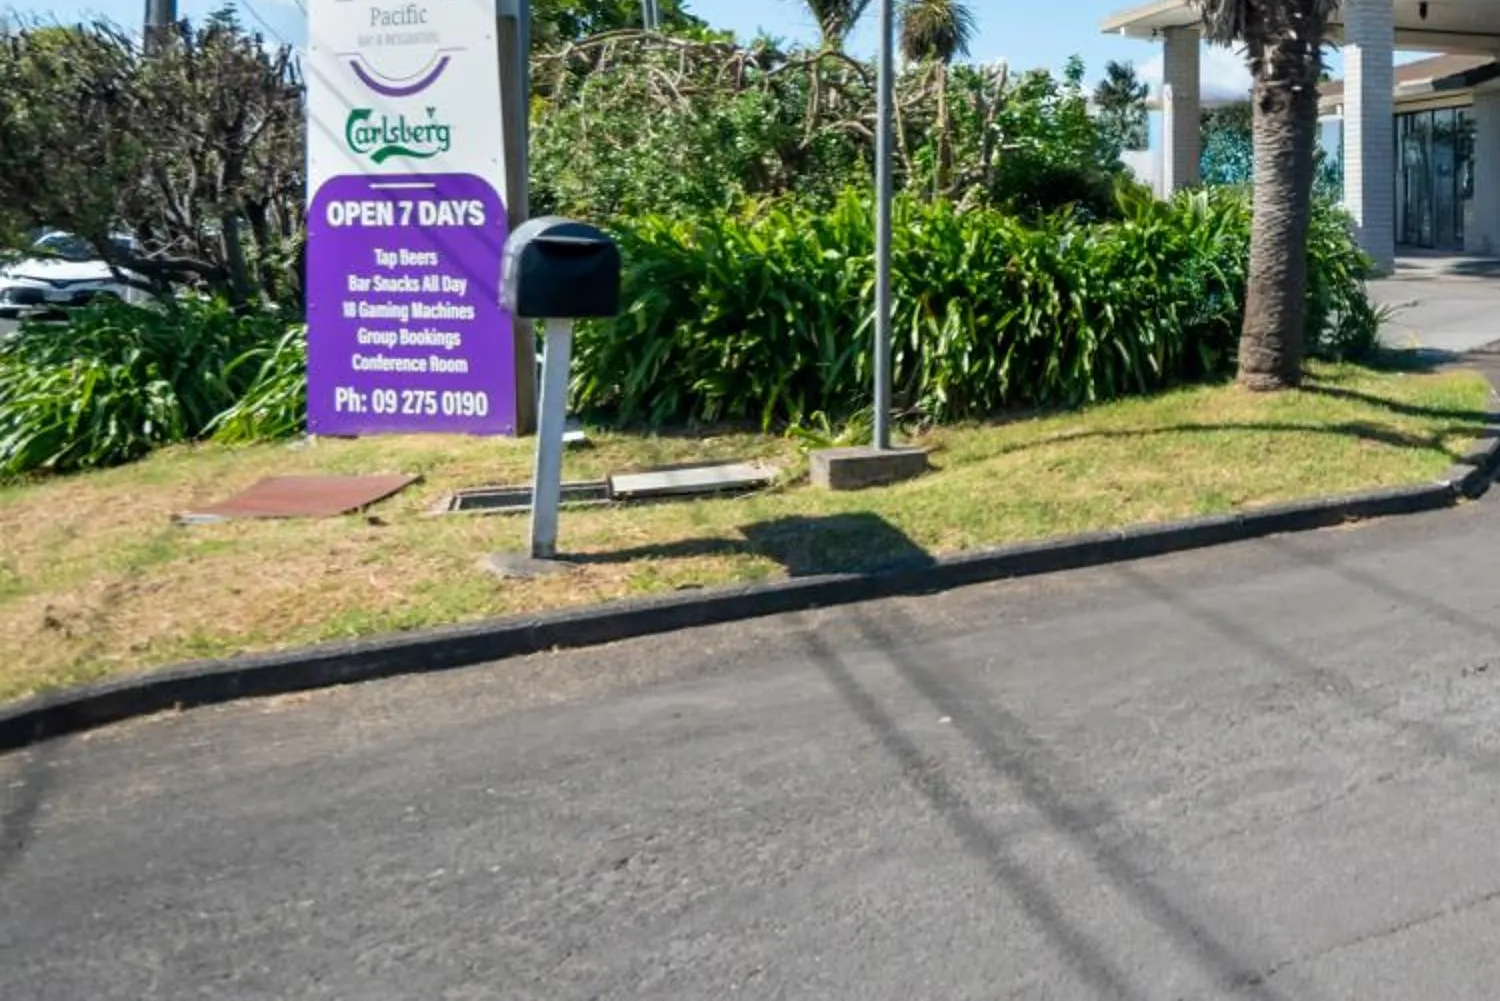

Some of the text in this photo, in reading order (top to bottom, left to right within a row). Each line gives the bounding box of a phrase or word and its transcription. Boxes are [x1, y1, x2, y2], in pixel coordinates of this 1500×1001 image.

[370, 3, 429, 27] Pacific
[345, 107, 452, 162] Carlsberg
[326, 200, 485, 227] OPEN 7 DAYS
[374, 248, 438, 268] Tap Beers
[348, 275, 467, 296] Bar Snacks All Day
[359, 302, 408, 322] Gaming
[411, 302, 475, 320] Machines
[357, 328, 461, 349] Group Bookings
[352, 353, 469, 373] Conference Room
[335, 387, 489, 416] Ph: 09 275 0190
